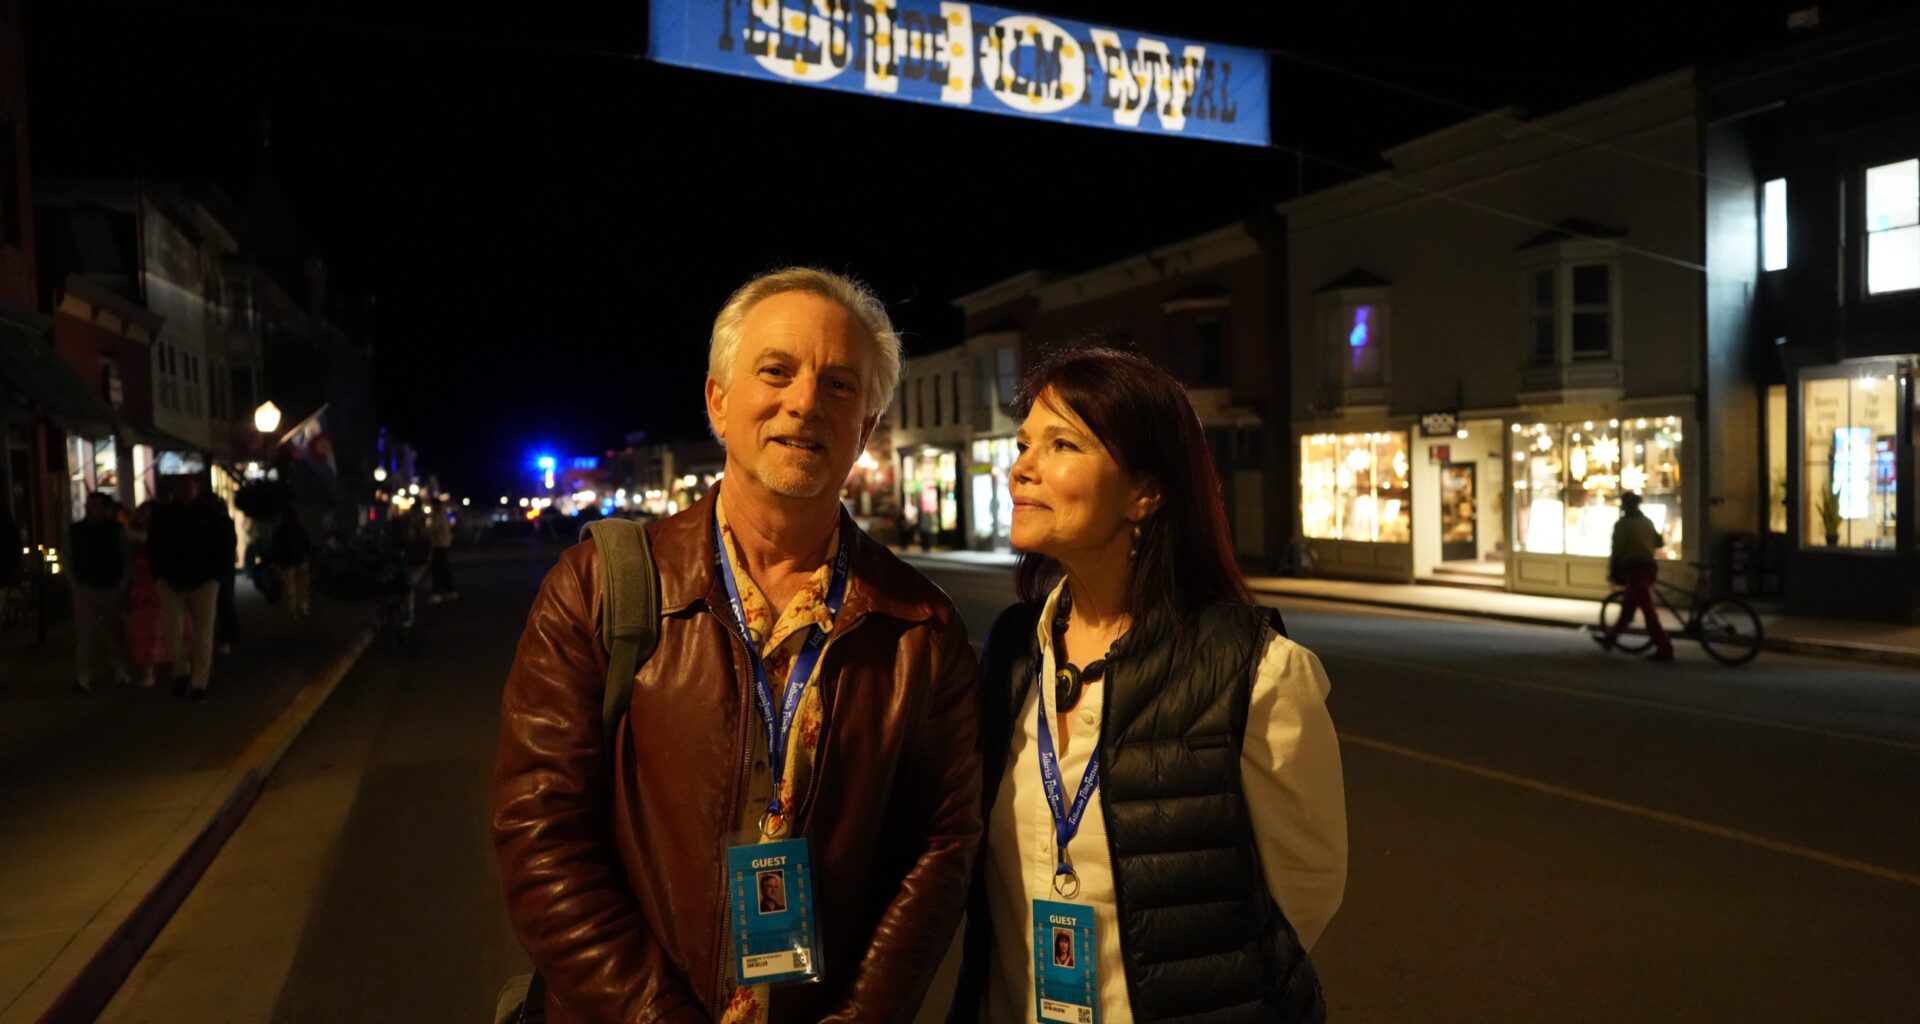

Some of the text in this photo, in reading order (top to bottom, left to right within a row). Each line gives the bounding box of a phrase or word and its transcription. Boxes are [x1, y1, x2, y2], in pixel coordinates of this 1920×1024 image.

[717, 0, 1238, 123] TELLURIDE FILM FESTIVAL
[751, 856, 787, 868] GUEST
[1049, 915, 1077, 926] GUEST
